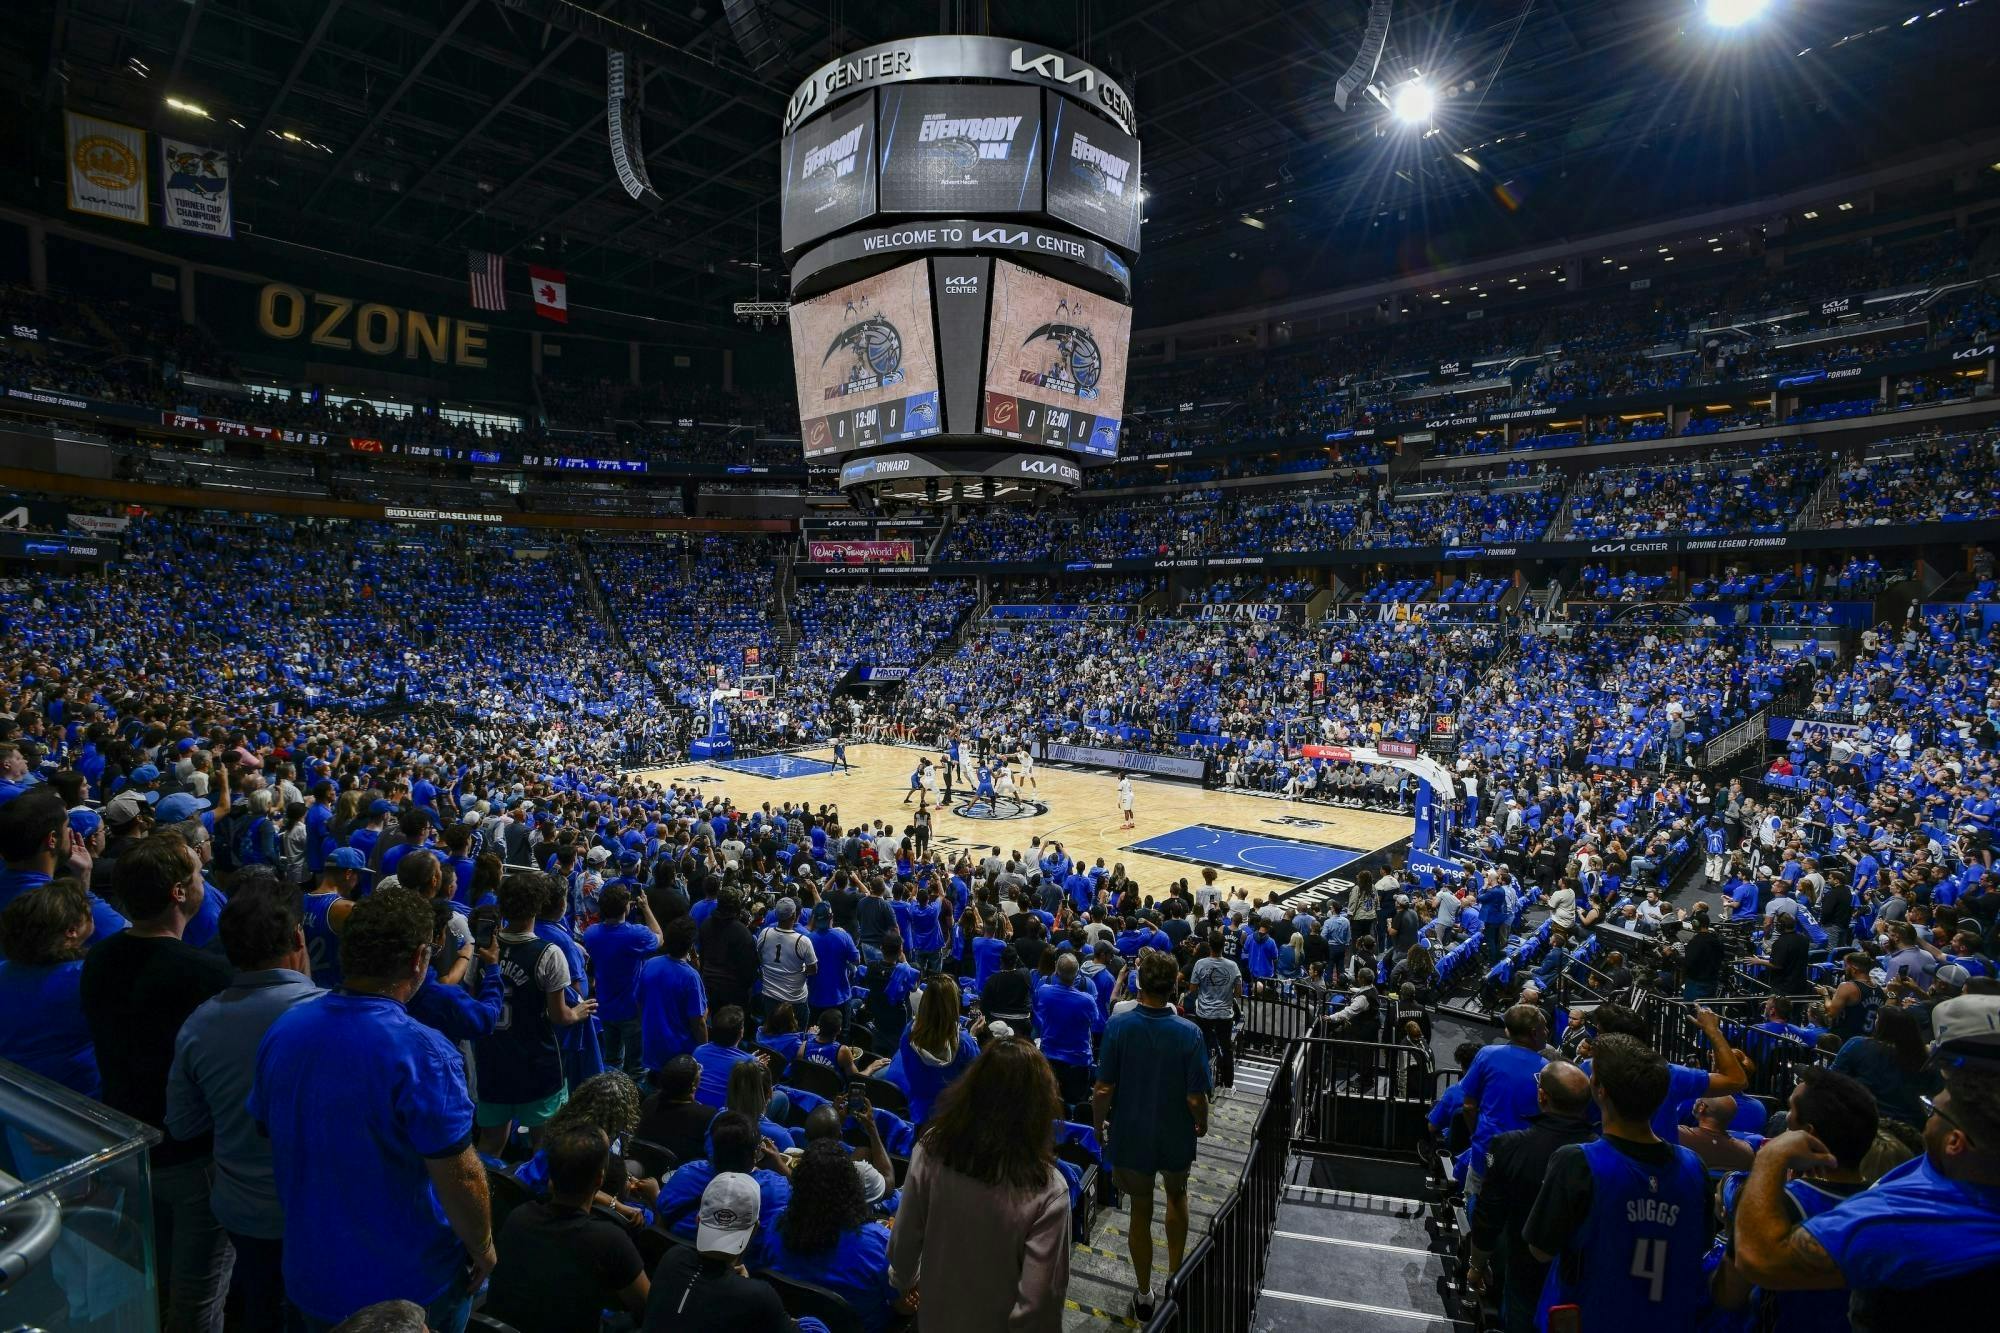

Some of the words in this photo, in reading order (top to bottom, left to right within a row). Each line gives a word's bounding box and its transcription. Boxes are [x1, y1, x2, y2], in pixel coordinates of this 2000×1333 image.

[824, 50, 911, 93] CENTER
[918, 116, 1022, 142] EVERYBODY
[802, 124, 864, 180] EVERYBODY
[979, 142, 1010, 160] IN
[837, 155, 856, 178] IN
[1071, 137, 1130, 183] EVERYBODY
[1106, 175, 1124, 198] IN
[175, 198, 205, 211] TURNER
[207, 205, 222, 214] CUP
[177, 208, 221, 223] CHAMPIONS
[864, 230, 937, 250] WELCOME
[941, 229, 962, 241] TO
[1037, 236, 1085, 253] CENTER
[945, 286, 978, 294] CENTER
[1822, 305, 1848, 315] CENTER
[259, 283, 489, 368] OZONE
[1827, 367, 1861, 379] FORWARD
[58, 398, 87, 409] FORWARD
[839, 420, 845, 438] 0
[855, 408, 877, 429] 12:00
[890, 408, 896, 428] 0
[1027, 410, 1036, 428] 0
[1046, 409, 1069, 429] 12:00
[1451, 416, 1477, 425] CENTER
[1530, 407, 1557, 416] FORWARD
[1078, 421, 1086, 438] 0
[876, 459, 910, 473] ORWARD
[386, 509, 407, 517] BUD
[408, 510, 436, 519] LIGHT
[439, 511, 482, 521] BASELINE
[483, 514, 503, 522] BAR
[70, 546, 98, 556] FORWARD
[870, 546, 893, 556] World
[1487, 548, 1516, 556] FORWARD
[1630, 542, 1668, 552] CENTER
[1686, 540, 1716, 550] DRIVING
[1718, 539, 1747, 549] LEGEND
[1748, 537, 1787, 547] FORWARD
[1048, 743, 1078, 761] PLAYOFFS
[1124, 753, 1158, 770] PLAYOFFS
[1157, 765, 1176, 773] Google
[1177, 766, 1189, 774] Pixel
[774, 943, 781, 963] 1
[1223, 941, 1237, 955] 22
[1399, 1010, 1422, 1018] SECURITY
[1626, 1198, 1681, 1227] SUGGS
[1630, 1237, 1669, 1302] 4
